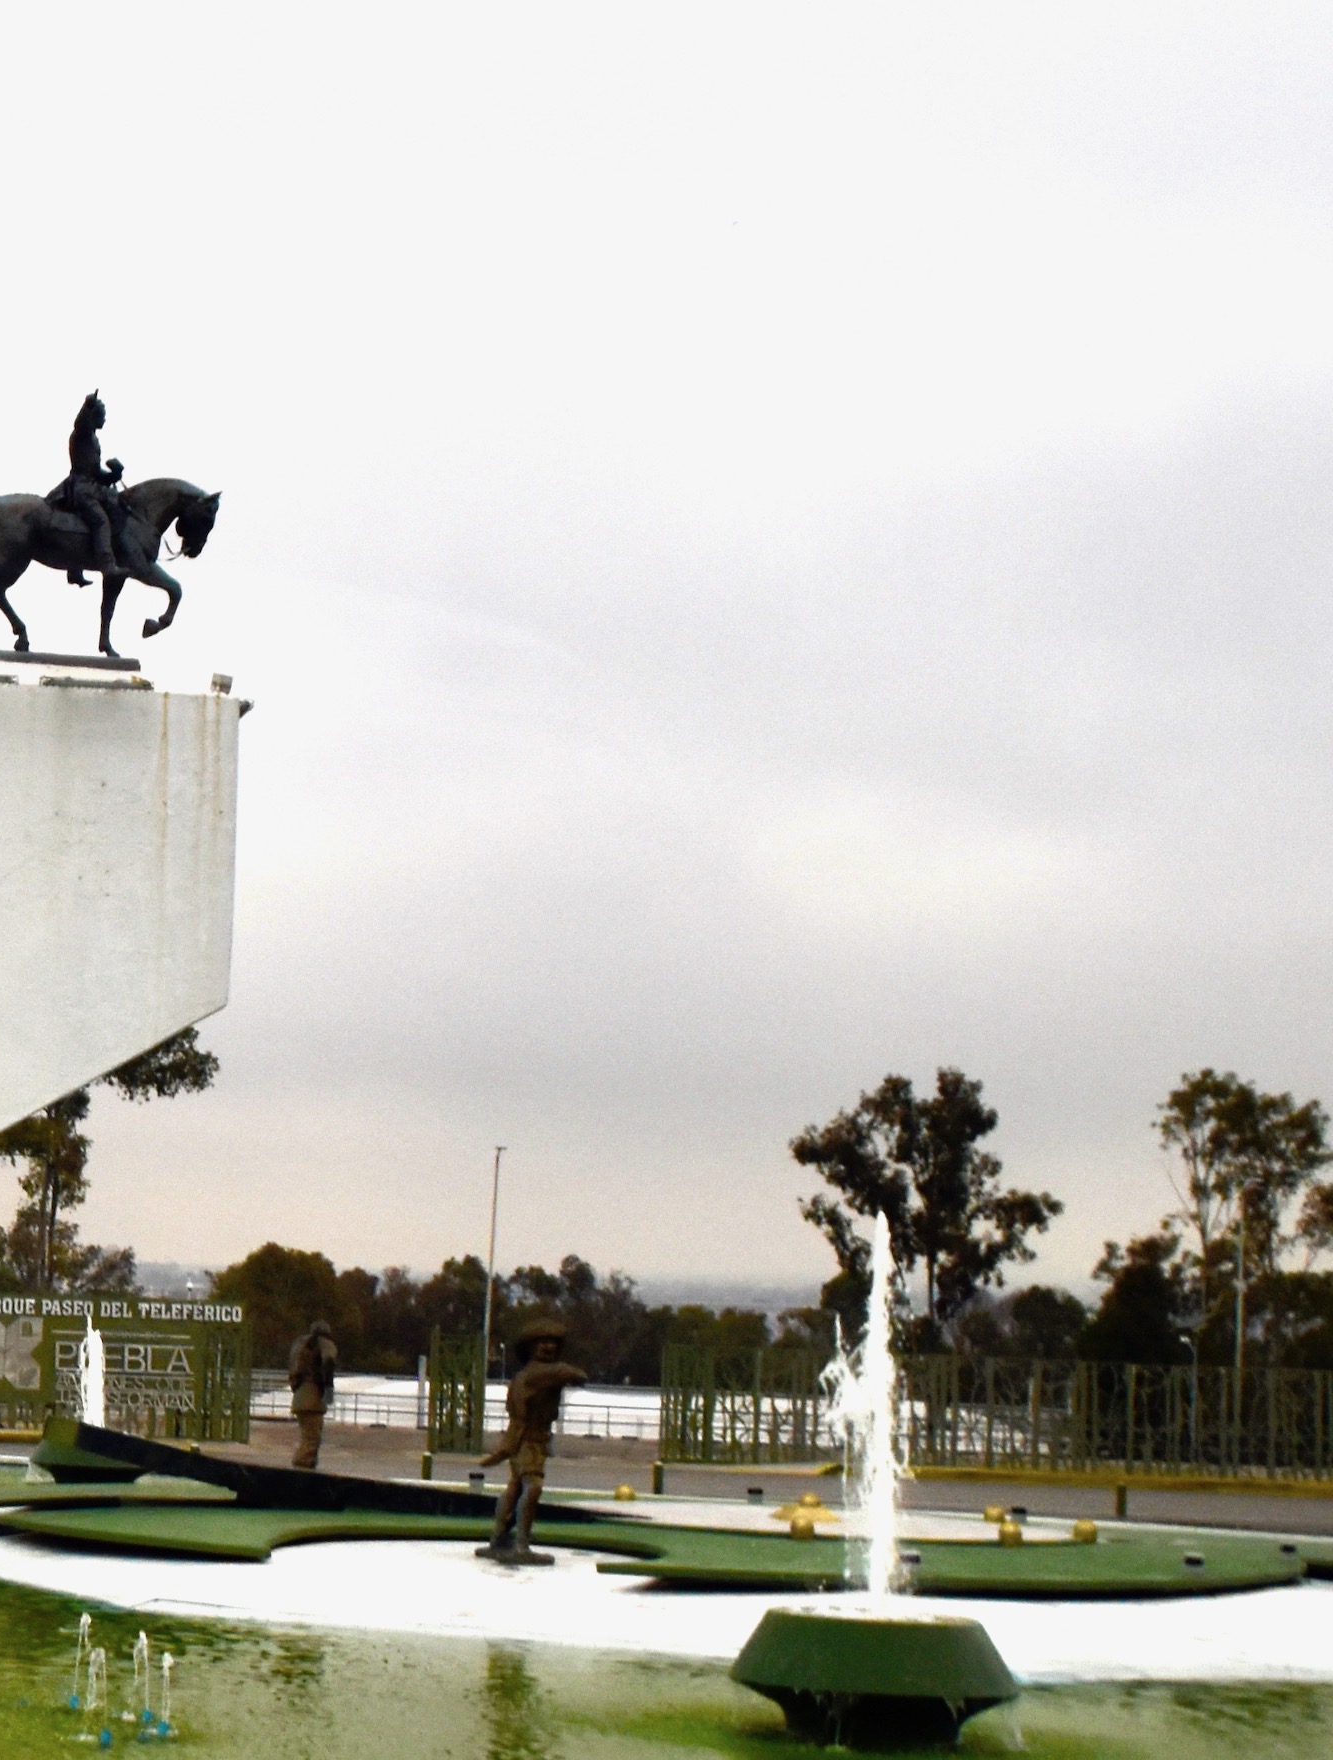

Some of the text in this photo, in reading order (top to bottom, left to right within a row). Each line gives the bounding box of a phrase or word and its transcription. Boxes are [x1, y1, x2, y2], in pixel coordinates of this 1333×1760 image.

[42, 1299, 93, 1317] PASEO
[100, 1301, 133, 1319] DEL
[55, 1341, 193, 1374] PEBLA
